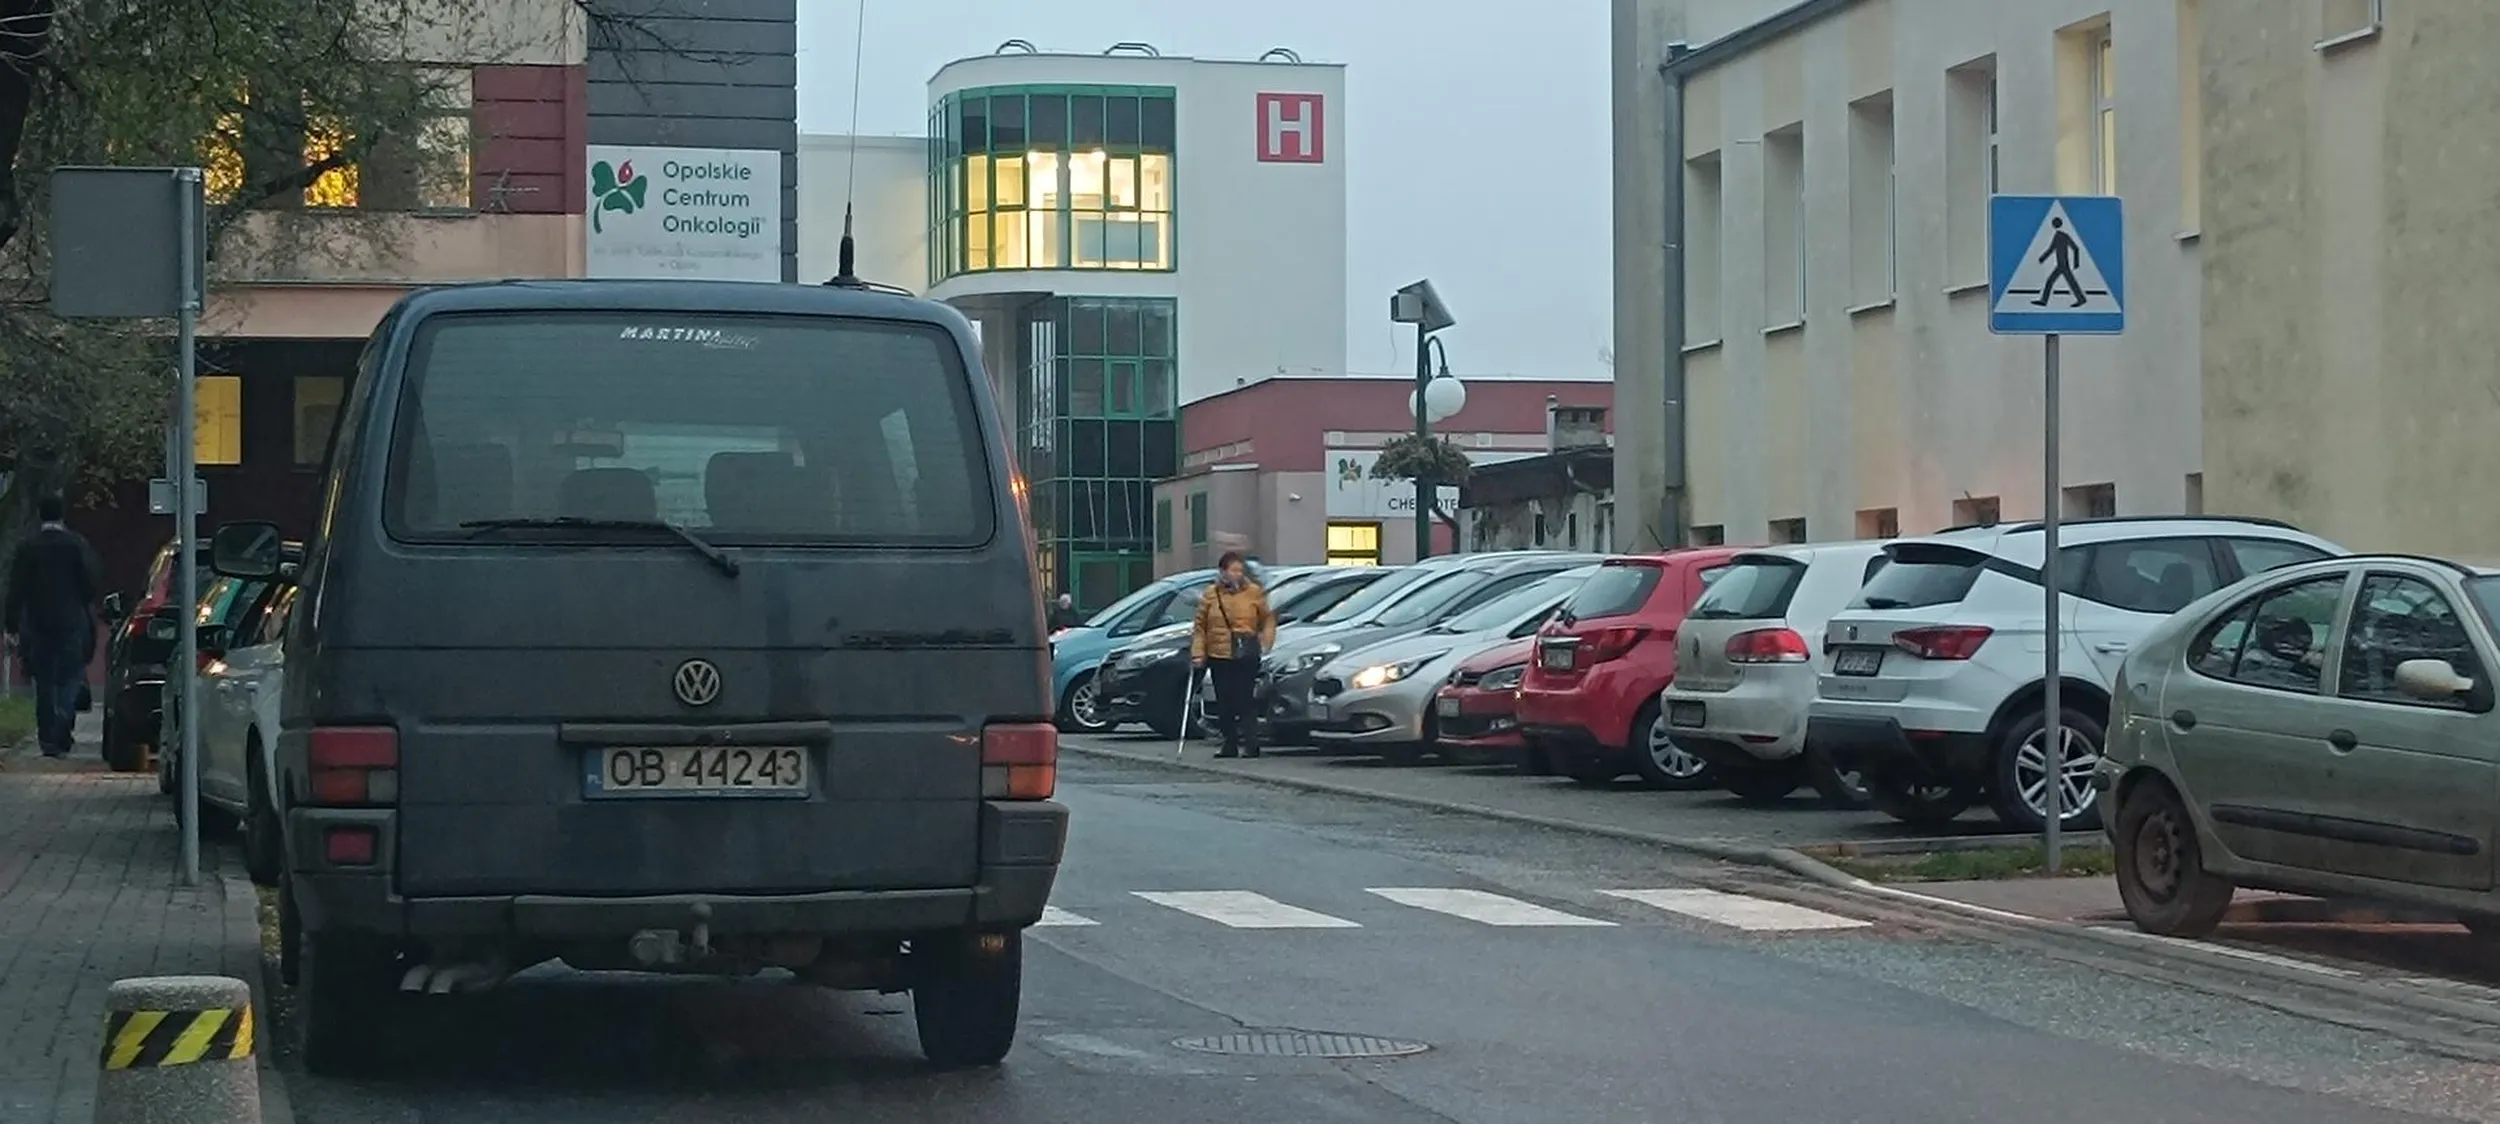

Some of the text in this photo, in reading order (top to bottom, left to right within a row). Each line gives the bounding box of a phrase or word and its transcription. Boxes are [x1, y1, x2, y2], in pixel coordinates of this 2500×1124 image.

[1268, 100, 1312, 155] H
[663, 160, 751, 182] Opolskie
[663, 188, 750, 207] Centrum
[663, 215, 761, 238] Onkologii
[682, 749, 802, 786] 44243
